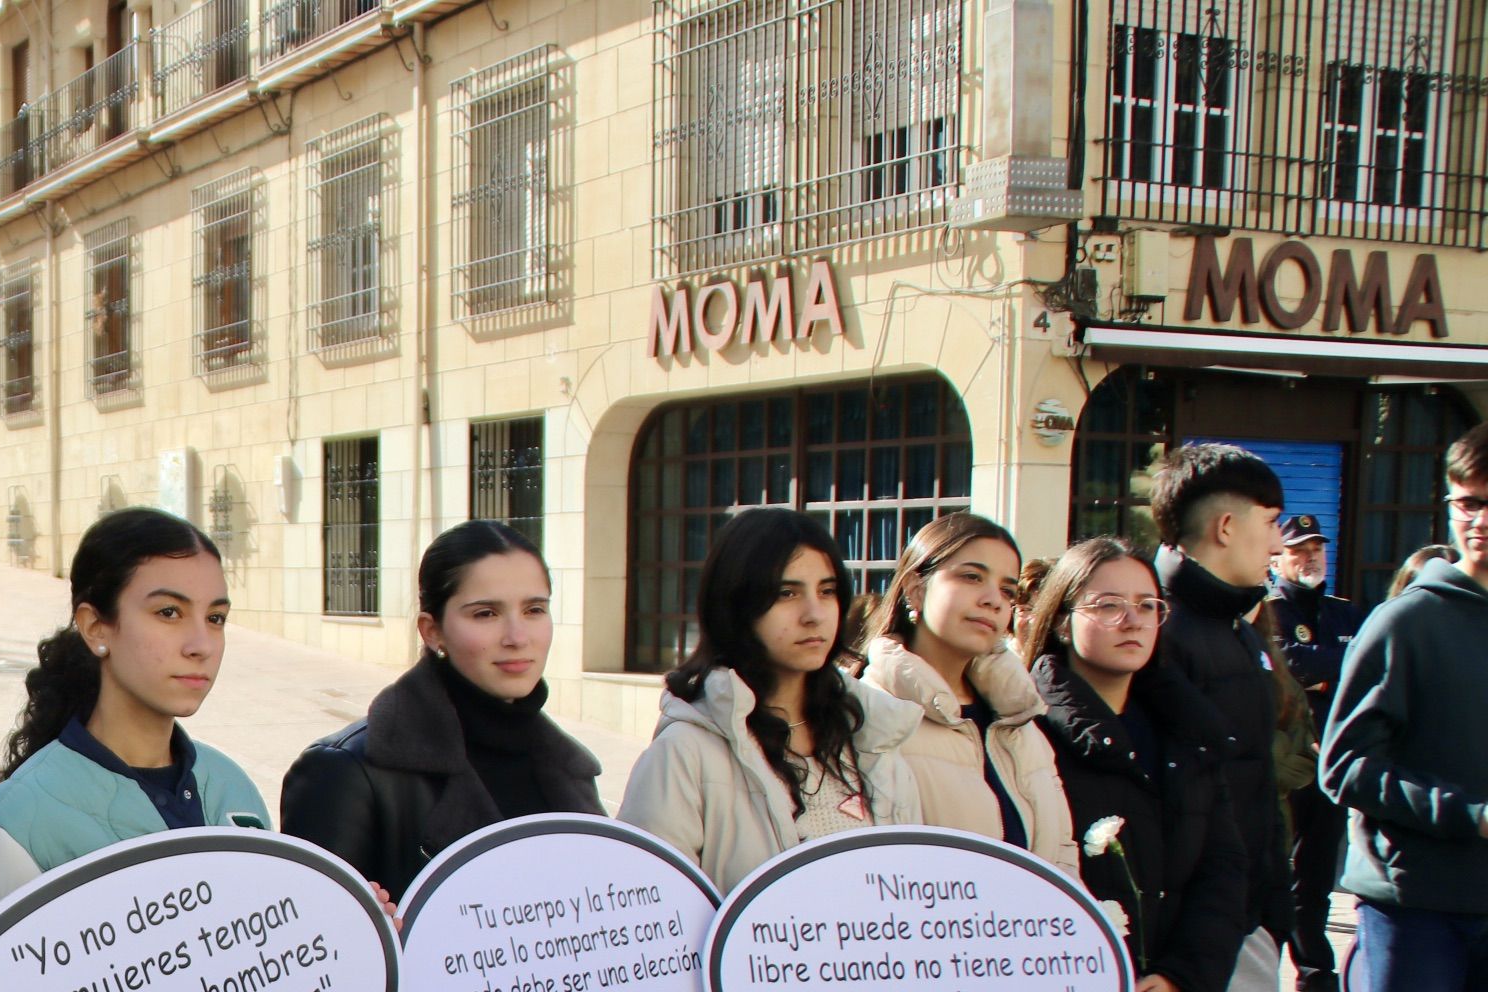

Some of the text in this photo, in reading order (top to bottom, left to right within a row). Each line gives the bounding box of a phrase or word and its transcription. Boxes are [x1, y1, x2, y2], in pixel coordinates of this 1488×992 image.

[647, 258, 846, 358] MOMA
[1183, 234, 1450, 339] MOMA
[1033, 310, 1051, 333] 4
[460, 883, 661, 929] "Tu cuerpo y la forma
[866, 874, 977, 909] "Ninguna
[11, 881, 212, 975] "Yo no deseo
[198, 897, 298, 957] tengan
[445, 910, 683, 978] en que lo compartes con el
[752, 911, 1076, 951] mujer puede considerarse
[598, 966, 629, 987] una
[633, 945, 703, 980] elección
[749, 947, 1104, 983] libre cuando no tiene control
